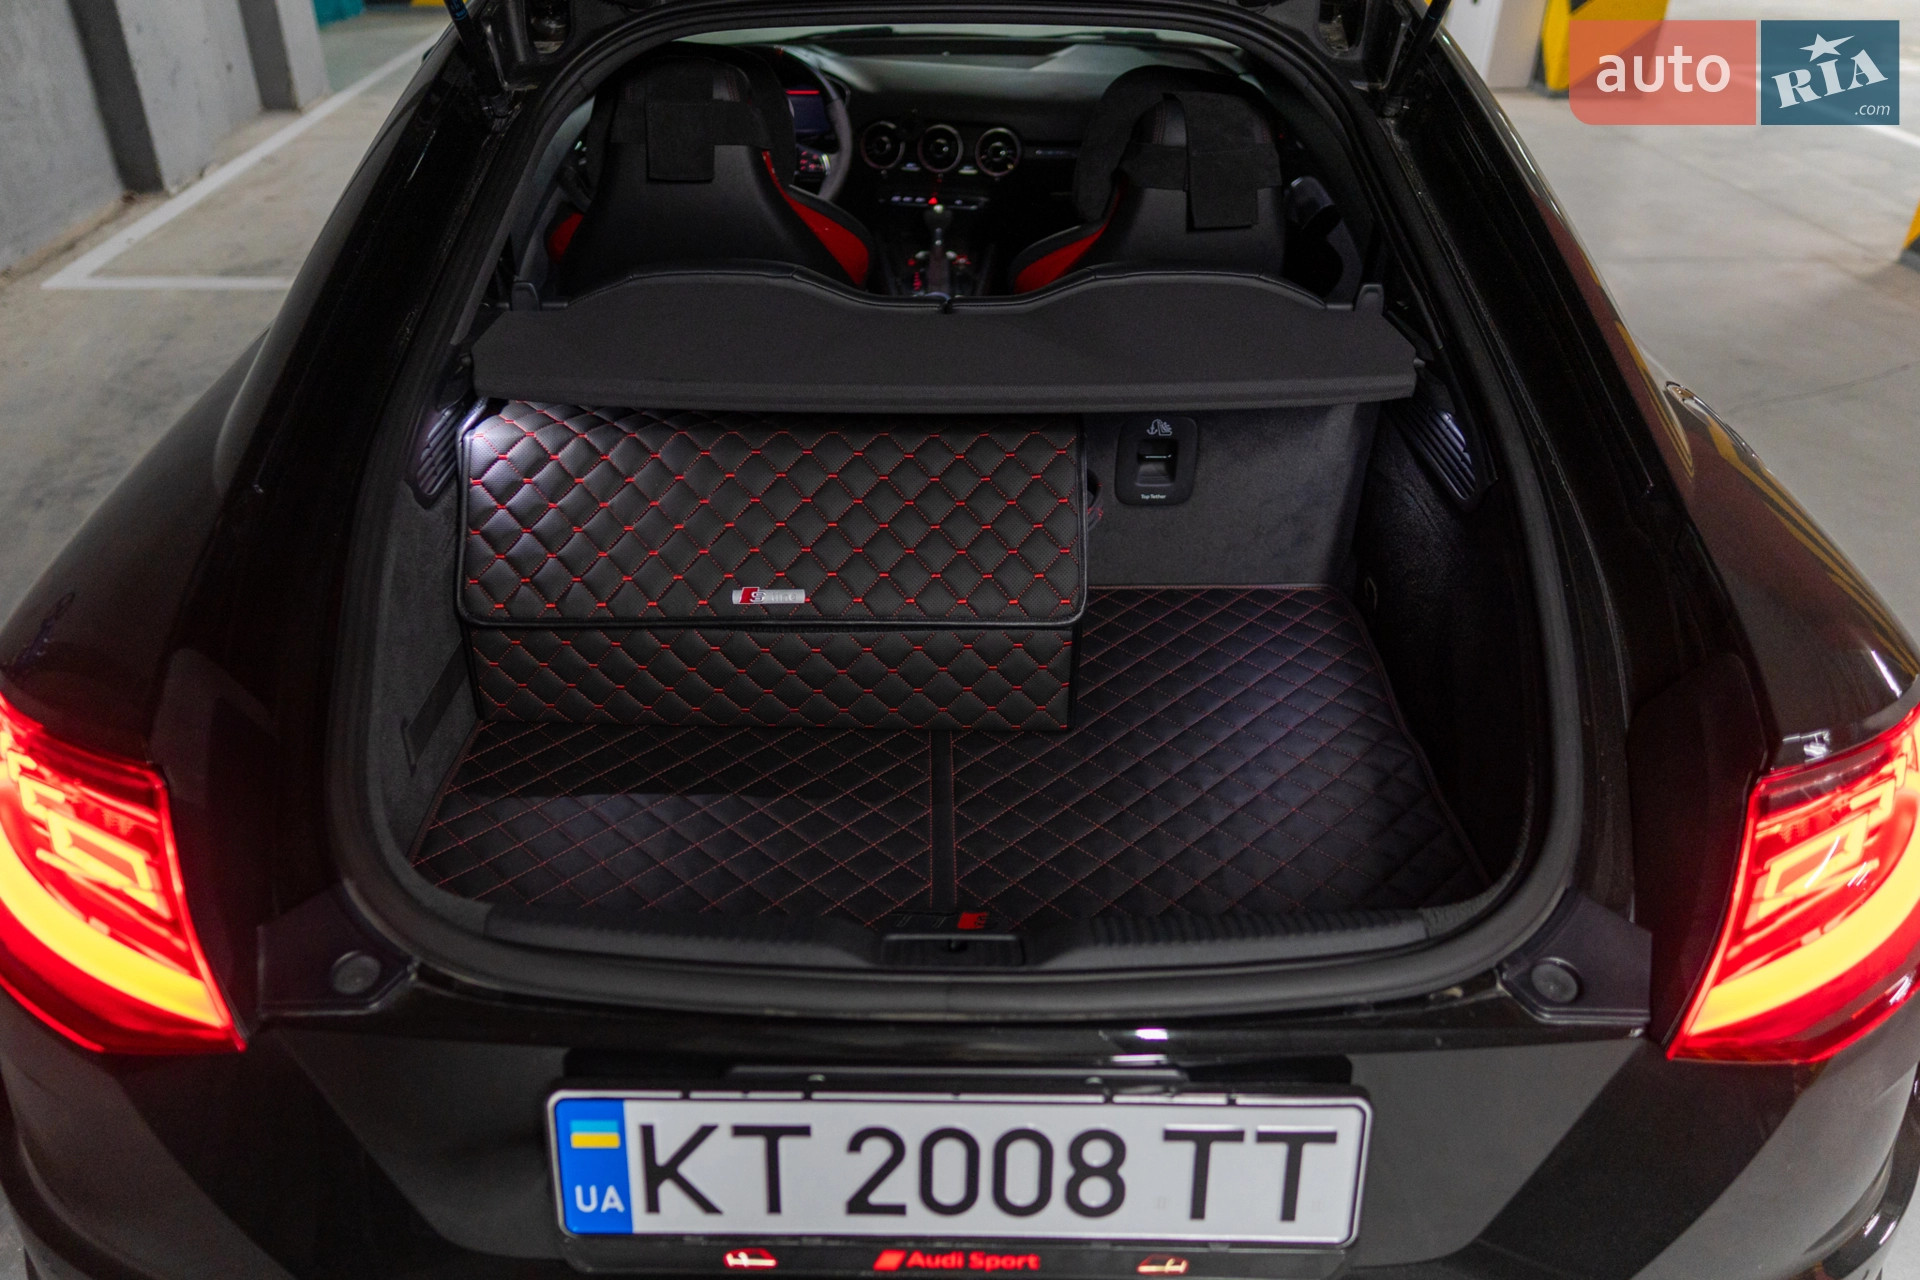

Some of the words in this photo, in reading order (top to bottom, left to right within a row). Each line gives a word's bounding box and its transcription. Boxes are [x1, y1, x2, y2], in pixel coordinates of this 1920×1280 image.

[772, 592, 797, 602] line
[640, 1124, 812, 1215] KT
[845, 1126, 1127, 1218] 2008
[1162, 1126, 1338, 1222] TT
[574, 1185, 625, 1213] UA
[906, 1251, 965, 1269] Audi
[968, 1251, 1041, 1272] Sport
